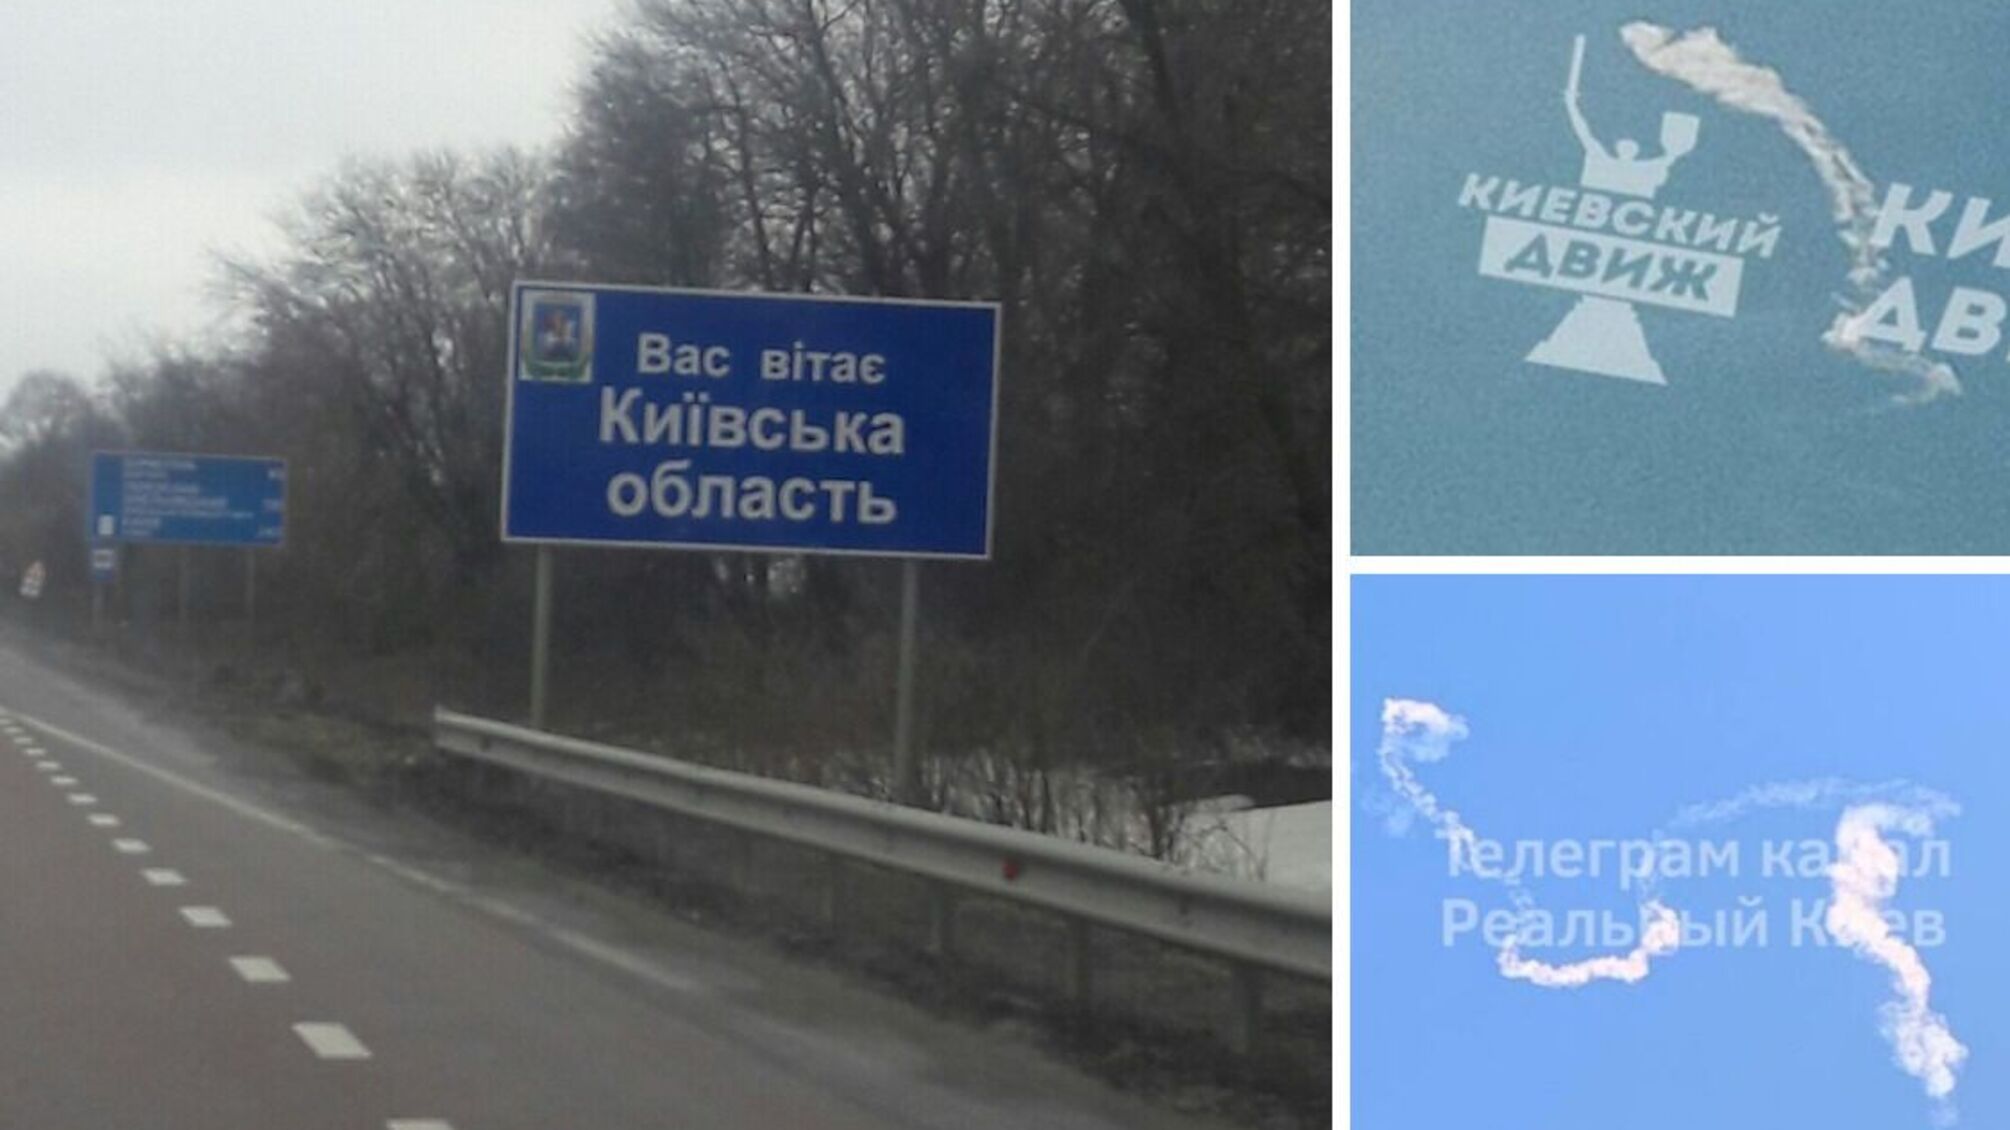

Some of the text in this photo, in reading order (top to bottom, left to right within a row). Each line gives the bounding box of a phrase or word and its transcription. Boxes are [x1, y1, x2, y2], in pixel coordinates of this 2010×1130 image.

[637, 332, 886, 383] Вас вітає
[600, 386, 905, 454] Київська
[606, 459, 897, 524] область
